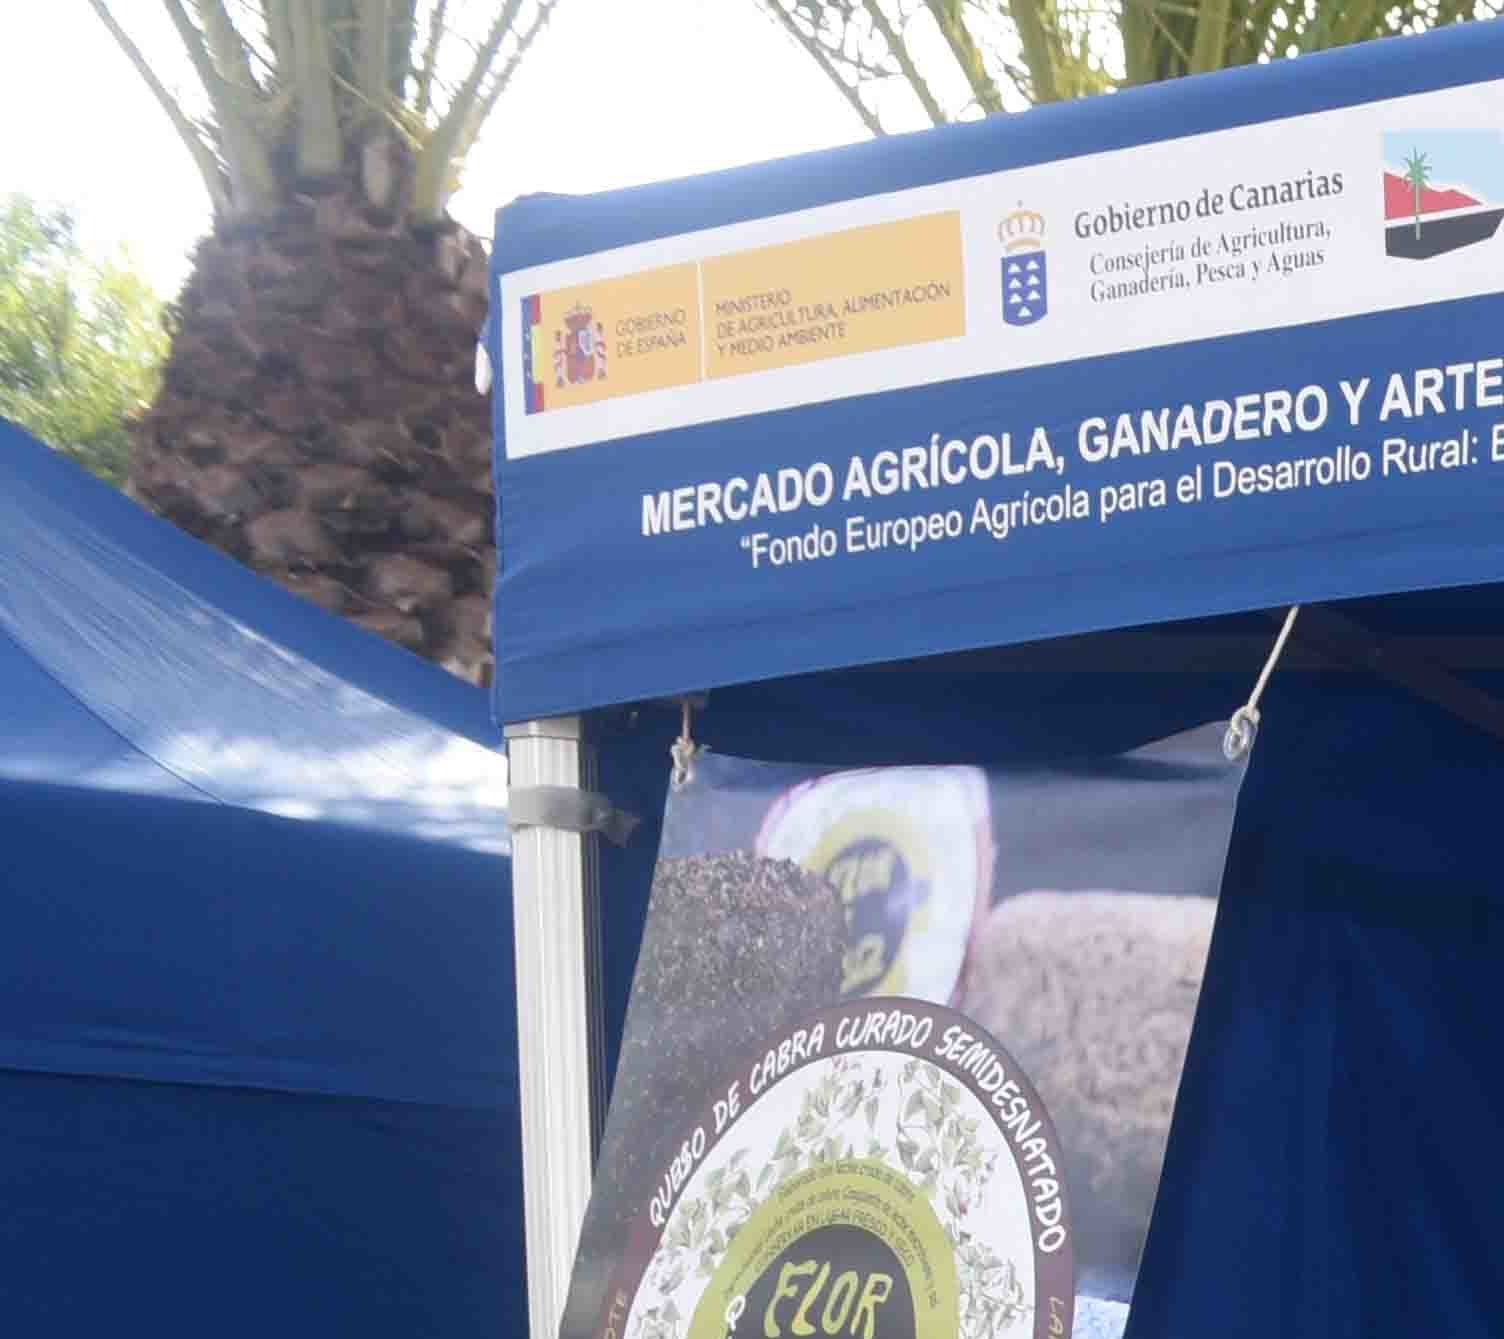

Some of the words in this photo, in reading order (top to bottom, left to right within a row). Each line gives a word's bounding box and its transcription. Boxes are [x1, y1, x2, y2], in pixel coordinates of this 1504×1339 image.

[1074, 200, 1191, 239] Gobierno
[1196, 188, 1224, 217] de
[1229, 168, 1344, 212] Canarias
[1089, 239, 1184, 277] Consejería
[1191, 236, 1211, 258] de
[1216, 219, 1331, 256] Agricultura,
[1090, 270, 1191, 303] Ganadería,
[1196, 259, 1246, 286] Pesca
[1251, 261, 1262, 280] y
[1267, 247, 1325, 276] Aguas
[615, 308, 686, 337] GOBIERNO
[715, 288, 791, 315] MINISTERIO
[717, 320, 737, 339] DE
[842, 279, 952, 313] ALIMENTACIÓN
[616, 341, 633, 358] DE
[636, 331, 686, 354] ESPAÑA
[716, 342, 727, 357] Y
[730, 335, 774, 356] MEDIO
[777, 321, 847, 349] AMBIENTE
[641, 461, 833, 537] MERCADO
[843, 426, 1065, 501] AGRÍCOLA,
[1078, 384, 1328, 462] GANADERO
[1340, 377, 1370, 426] Y
[846, 509, 963, 553] Europeo
[970, 483, 1089, 540] Agrícola
[1100, 476, 1166, 523] para
[1177, 470, 1202, 502] el
[1214, 445, 1371, 498] Desarrollo
[1383, 429, 1478, 476] Rural:
[713, 1080, 741, 1134] DE
[750, 1023, 825, 1094] CABRA
[835, 1010, 933, 1048] CURADO
[935, 1026, 1066, 1253] SEMIDESNATADO
